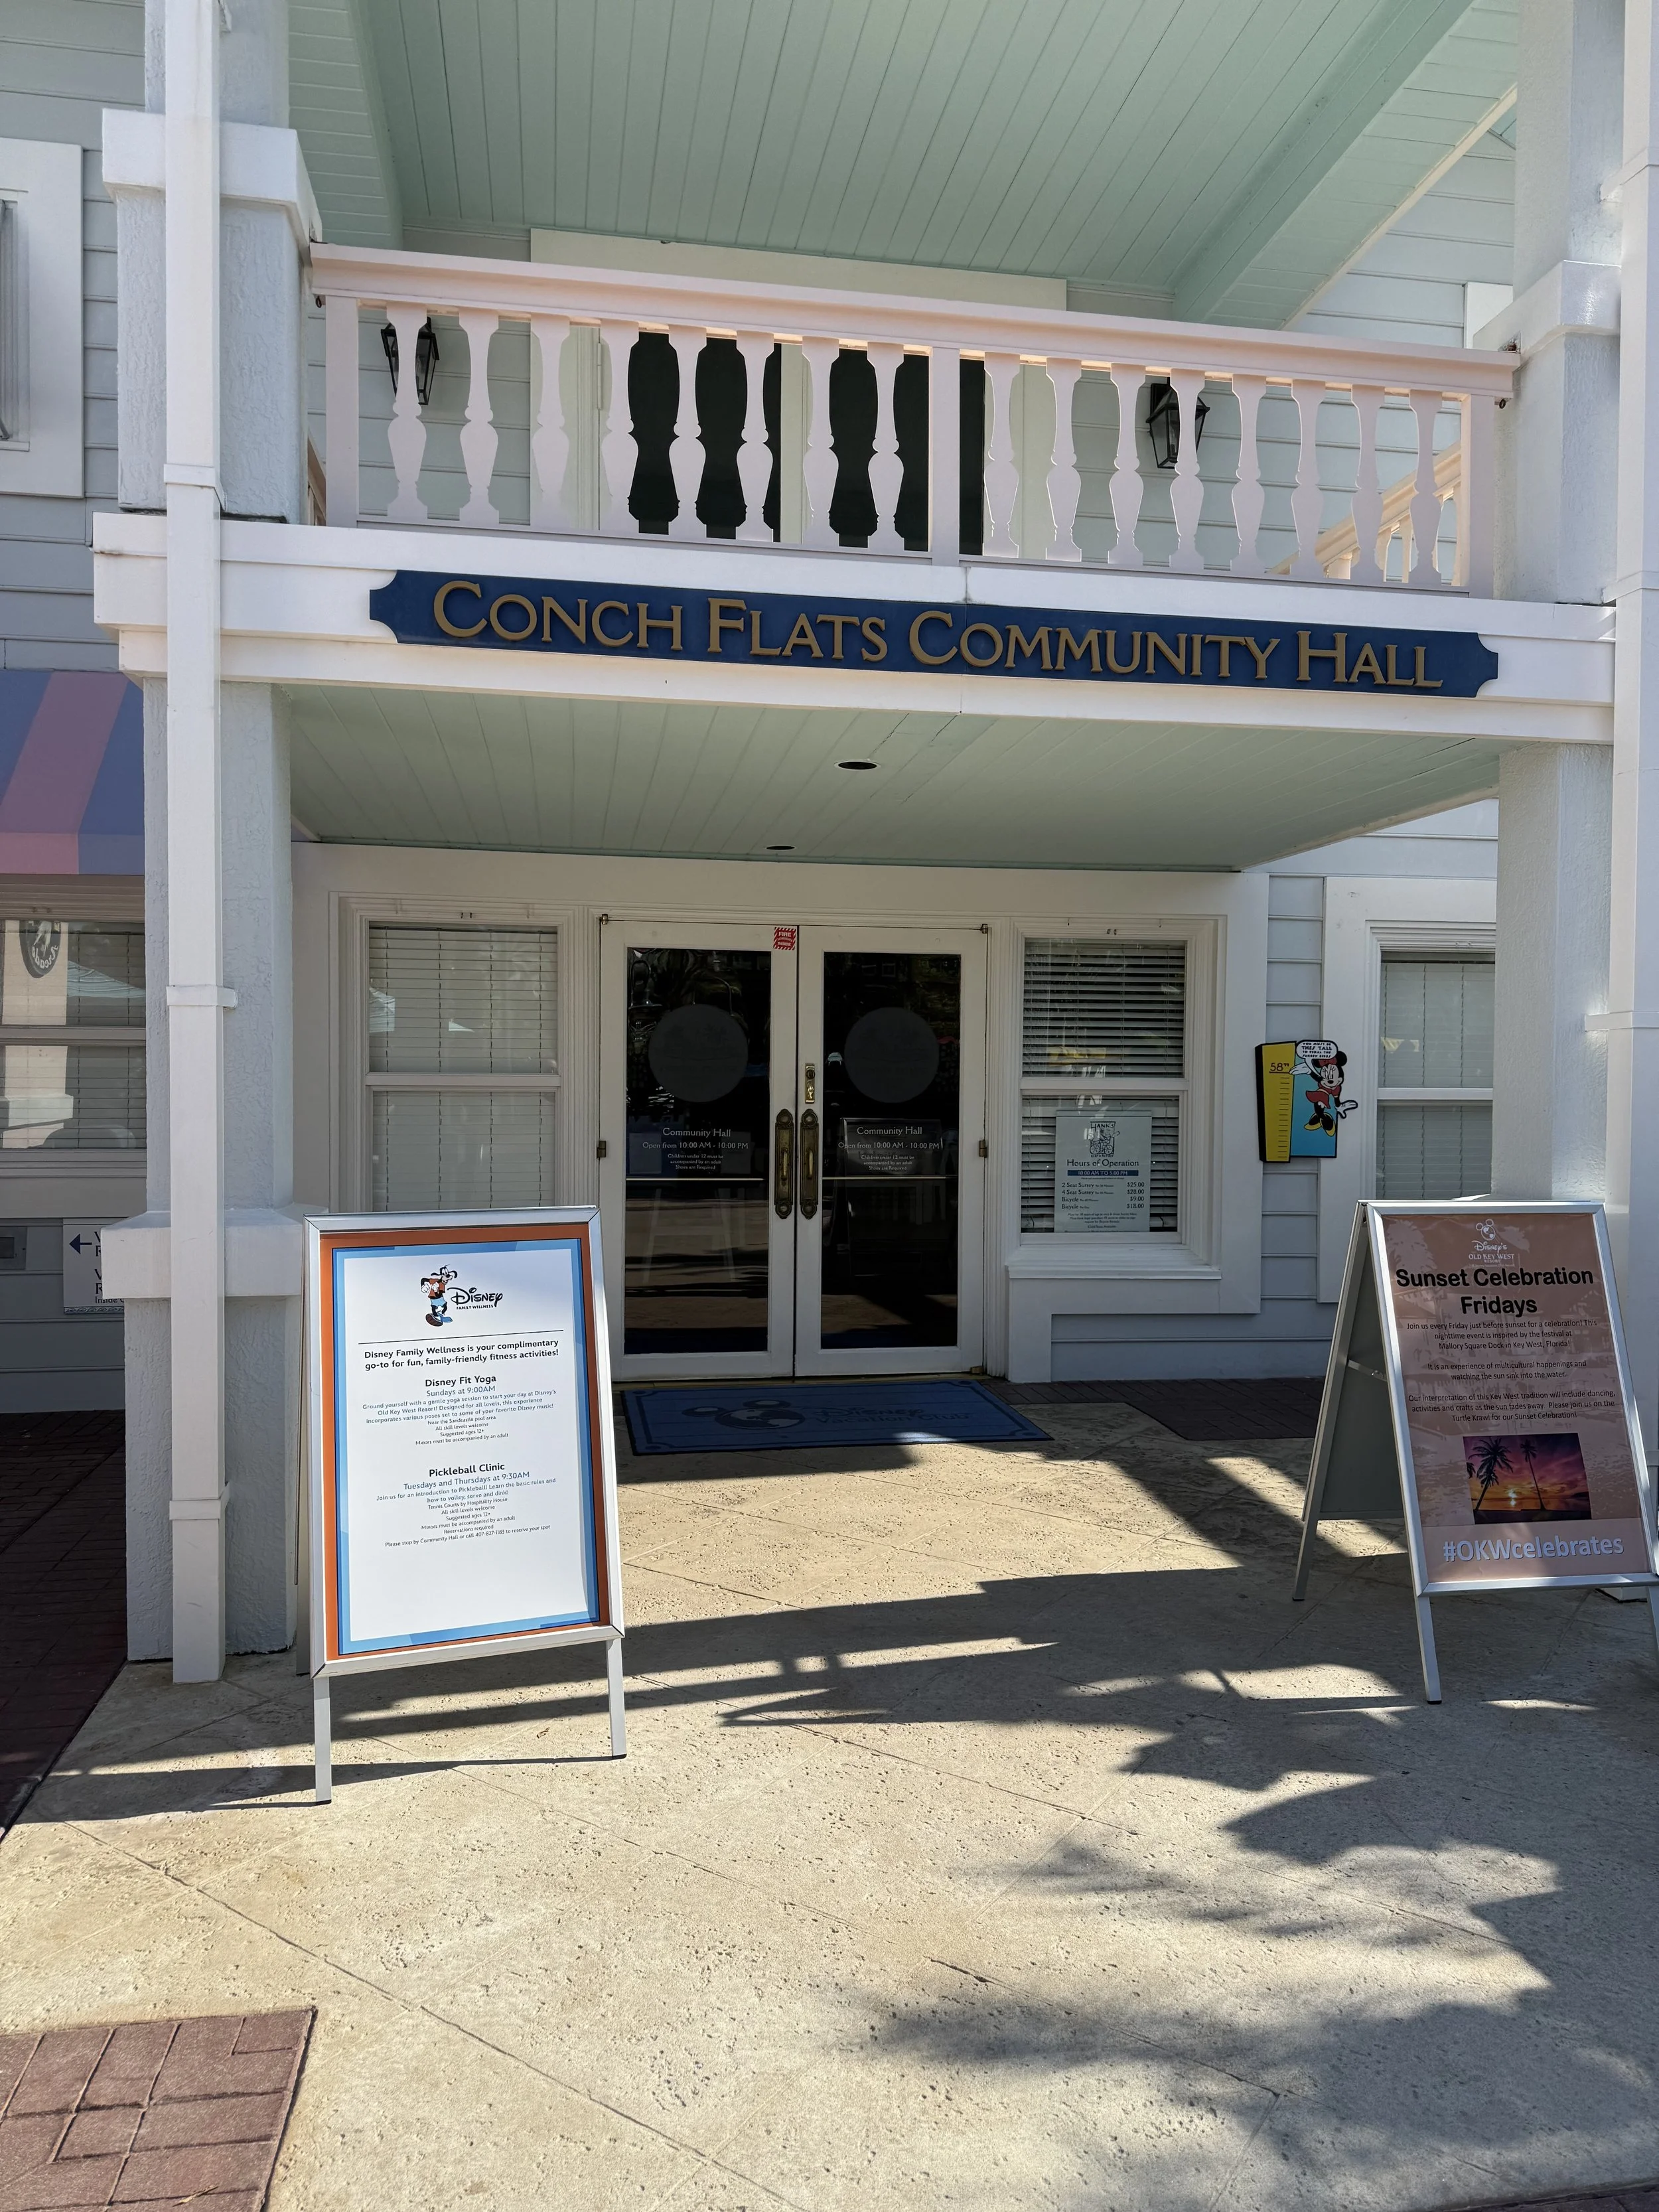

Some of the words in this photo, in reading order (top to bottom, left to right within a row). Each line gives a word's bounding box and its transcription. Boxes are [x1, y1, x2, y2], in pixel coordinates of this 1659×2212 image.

[433, 579, 684, 652] CONCH
[707, 597, 889, 662] FLATS
[908, 609, 1281, 680] COMMUNITY
[1296, 630, 1444, 689] HALL
[662, 1127, 711, 1138] Community
[713, 1128, 731, 1137] Hall
[856, 1126, 903, 1136] Community
[905, 1126, 922, 1134] Hall
[1471, 1240, 1508, 1253] Disney's
[1397, 1270, 1469, 1286] Sunset
[1475, 1268, 1592, 1285] Celebration
[447, 1287, 503, 1307] Disney
[1461, 1297, 1536, 1316] Fridays
[1434, 1332, 1465, 1341] nighttime
[1492, 1331, 1518, 1339] inspired
[396, 1348, 424, 1357] Family
[476, 1345, 495, 1353] your
[497, 1340, 559, 1350] complimentary
[1439, 1342, 1463, 1351] Mallory
[1464, 1342, 1486, 1351] Square
[365, 1362, 389, 1371] go-to
[425, 1354, 487, 1365] family-friendly
[519, 1349, 558, 1358] activities!
[1450, 1363, 1485, 1371] experience
[1536, 1361, 1573, 1369] happenings
[1573, 1359, 1587, 1368] and
[425, 1378, 457, 1387] Disney
[474, 1375, 496, 1384] Yoga
[1451, 1372, 1480, 1381] watching
[426, 1388, 456, 1397] Sundays
[1537, 1410, 1577, 1419] Celebration!
[429, 1465, 476, 1477] Pickleball
[478, 1463, 504, 1472] Clinic
[403, 1481, 437, 1490] Tuesdays
[454, 1475, 490, 1485] Thursdays
[501, 1471, 530, 1480] 9:30AM
[1443, 1534, 1624, 1562] #OKWcelebrates
